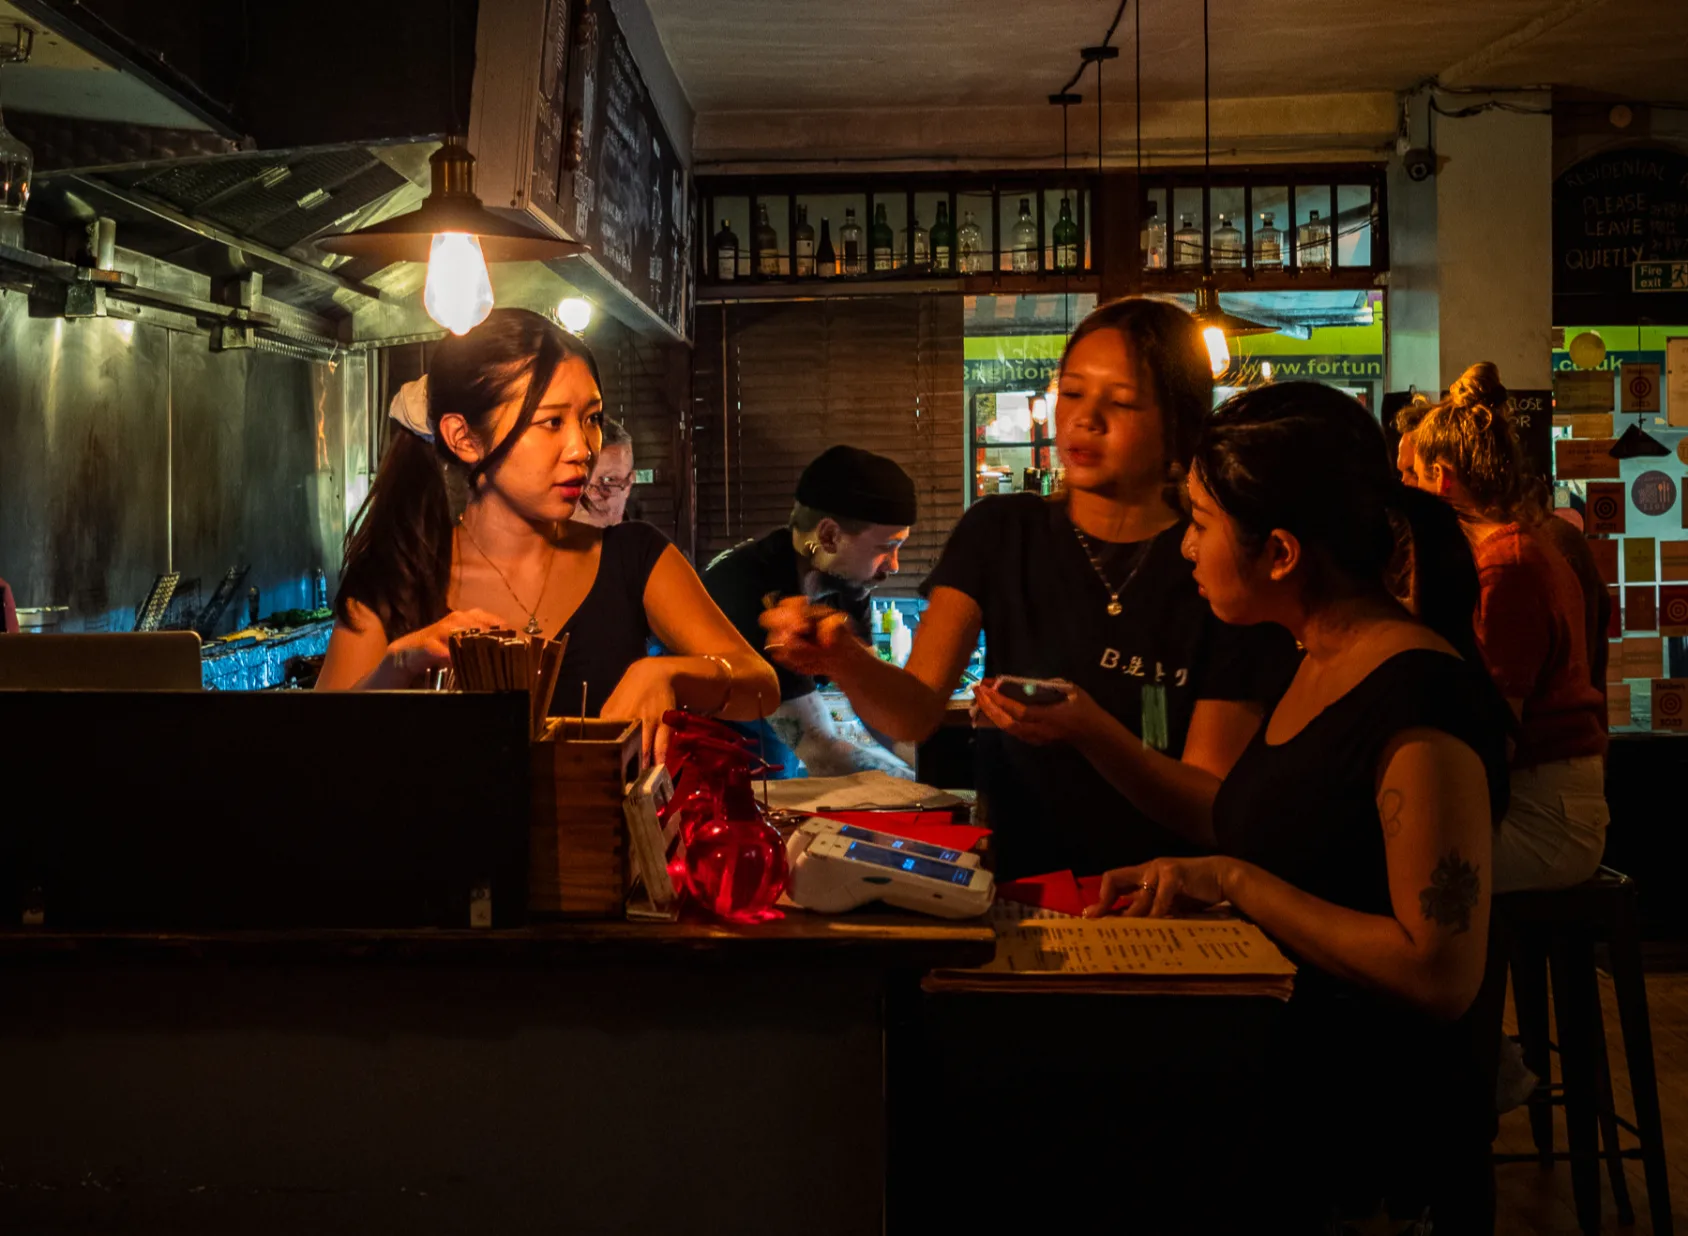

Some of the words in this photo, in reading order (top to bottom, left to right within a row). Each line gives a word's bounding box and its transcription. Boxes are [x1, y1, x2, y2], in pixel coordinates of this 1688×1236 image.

[1582, 192, 1647, 217] PLEASE
[1584, 217, 1645, 236] LEAVE
[1565, 242, 1645, 270] QUIETLY
[1640, 264, 1663, 277] Fire
[1640, 276, 1662, 288] exit
